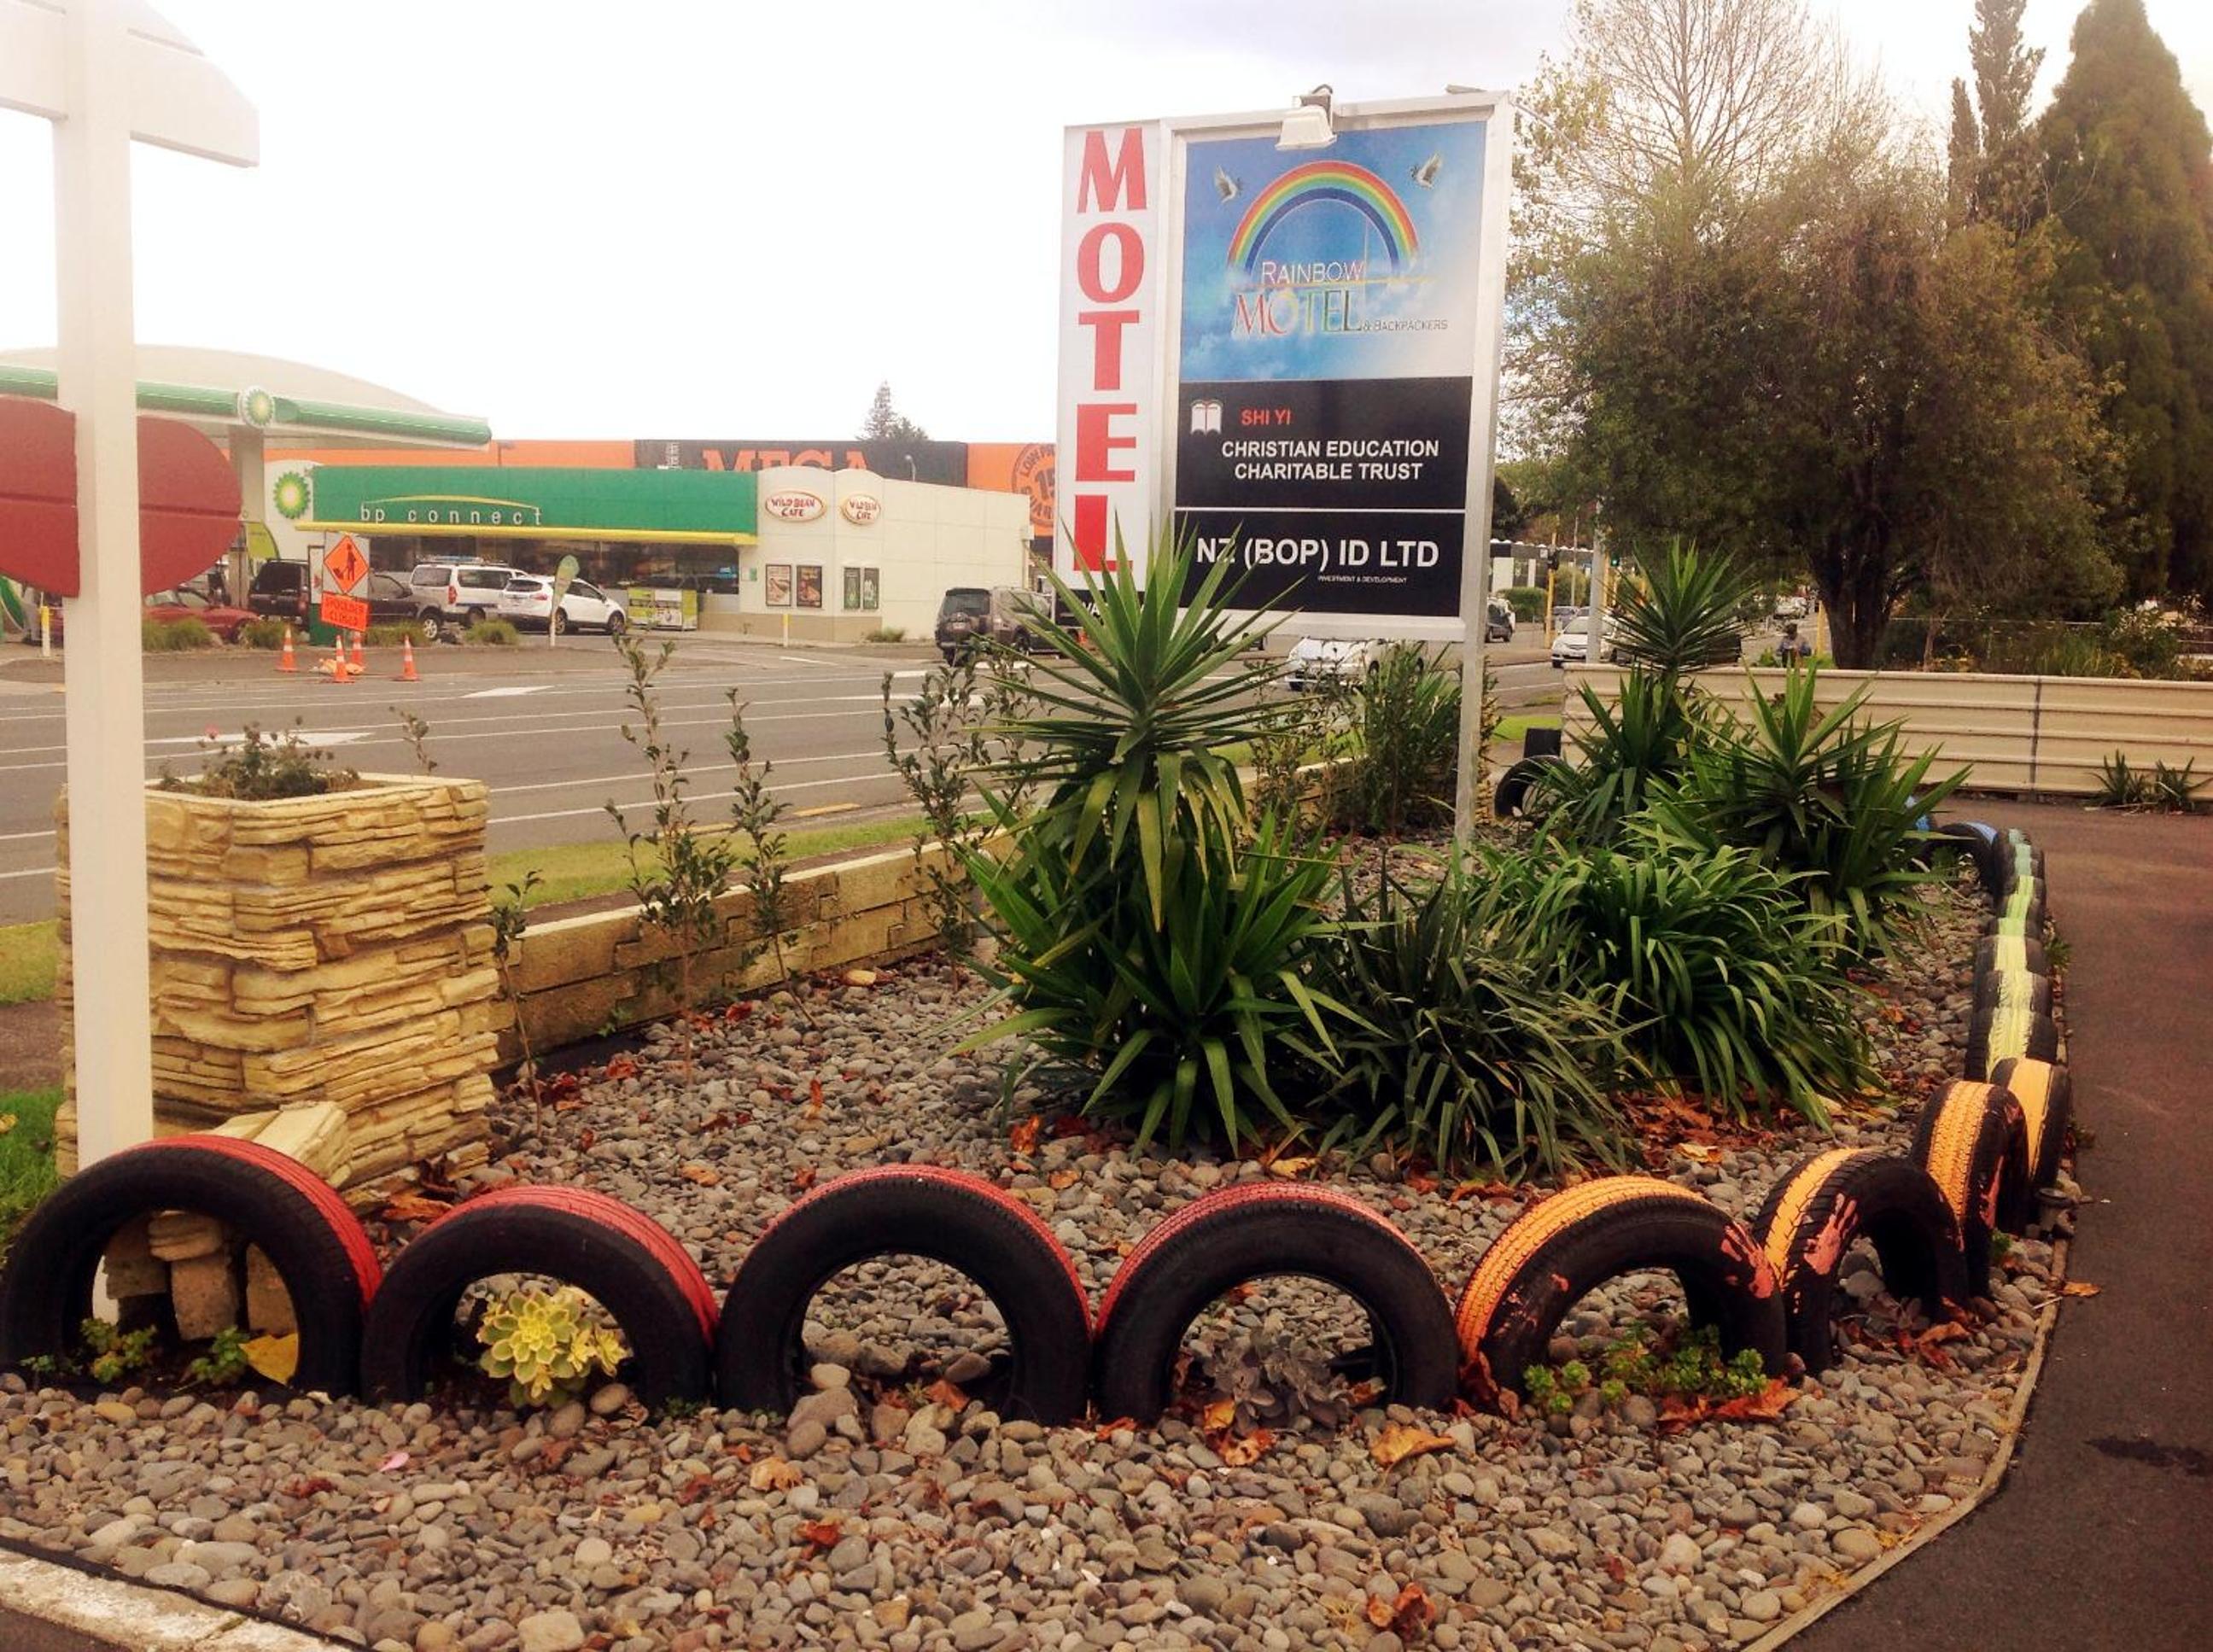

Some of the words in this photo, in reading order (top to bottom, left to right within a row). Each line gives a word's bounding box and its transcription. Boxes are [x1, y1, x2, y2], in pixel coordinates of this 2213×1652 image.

[1261, 261, 1364, 284] RAINBOW
[1234, 289, 1363, 334] MOTEL
[1363, 321, 1369, 331] &
[1373, 319, 1449, 331] BACKPACKERS
[1073, 127, 1147, 571] MOTEL
[1241, 409, 1270, 425] SHI
[1275, 409, 1291, 425] YI
[1222, 441, 1321, 458] CHRISTIAN
[1327, 440, 1439, 457] EDUCATION
[1235, 463, 1352, 480] CHARITABLE
[1359, 463, 1422, 480] TRUST
[360, 503, 385, 523] bp
[408, 507, 541, 525] connect
[771, 499, 793, 507] WILD
[1197, 538, 1235, 563] NZ
[1245, 538, 1329, 572] (BOP)
[1339, 540, 1369, 565] ID
[1381, 540, 1439, 567] LTD
